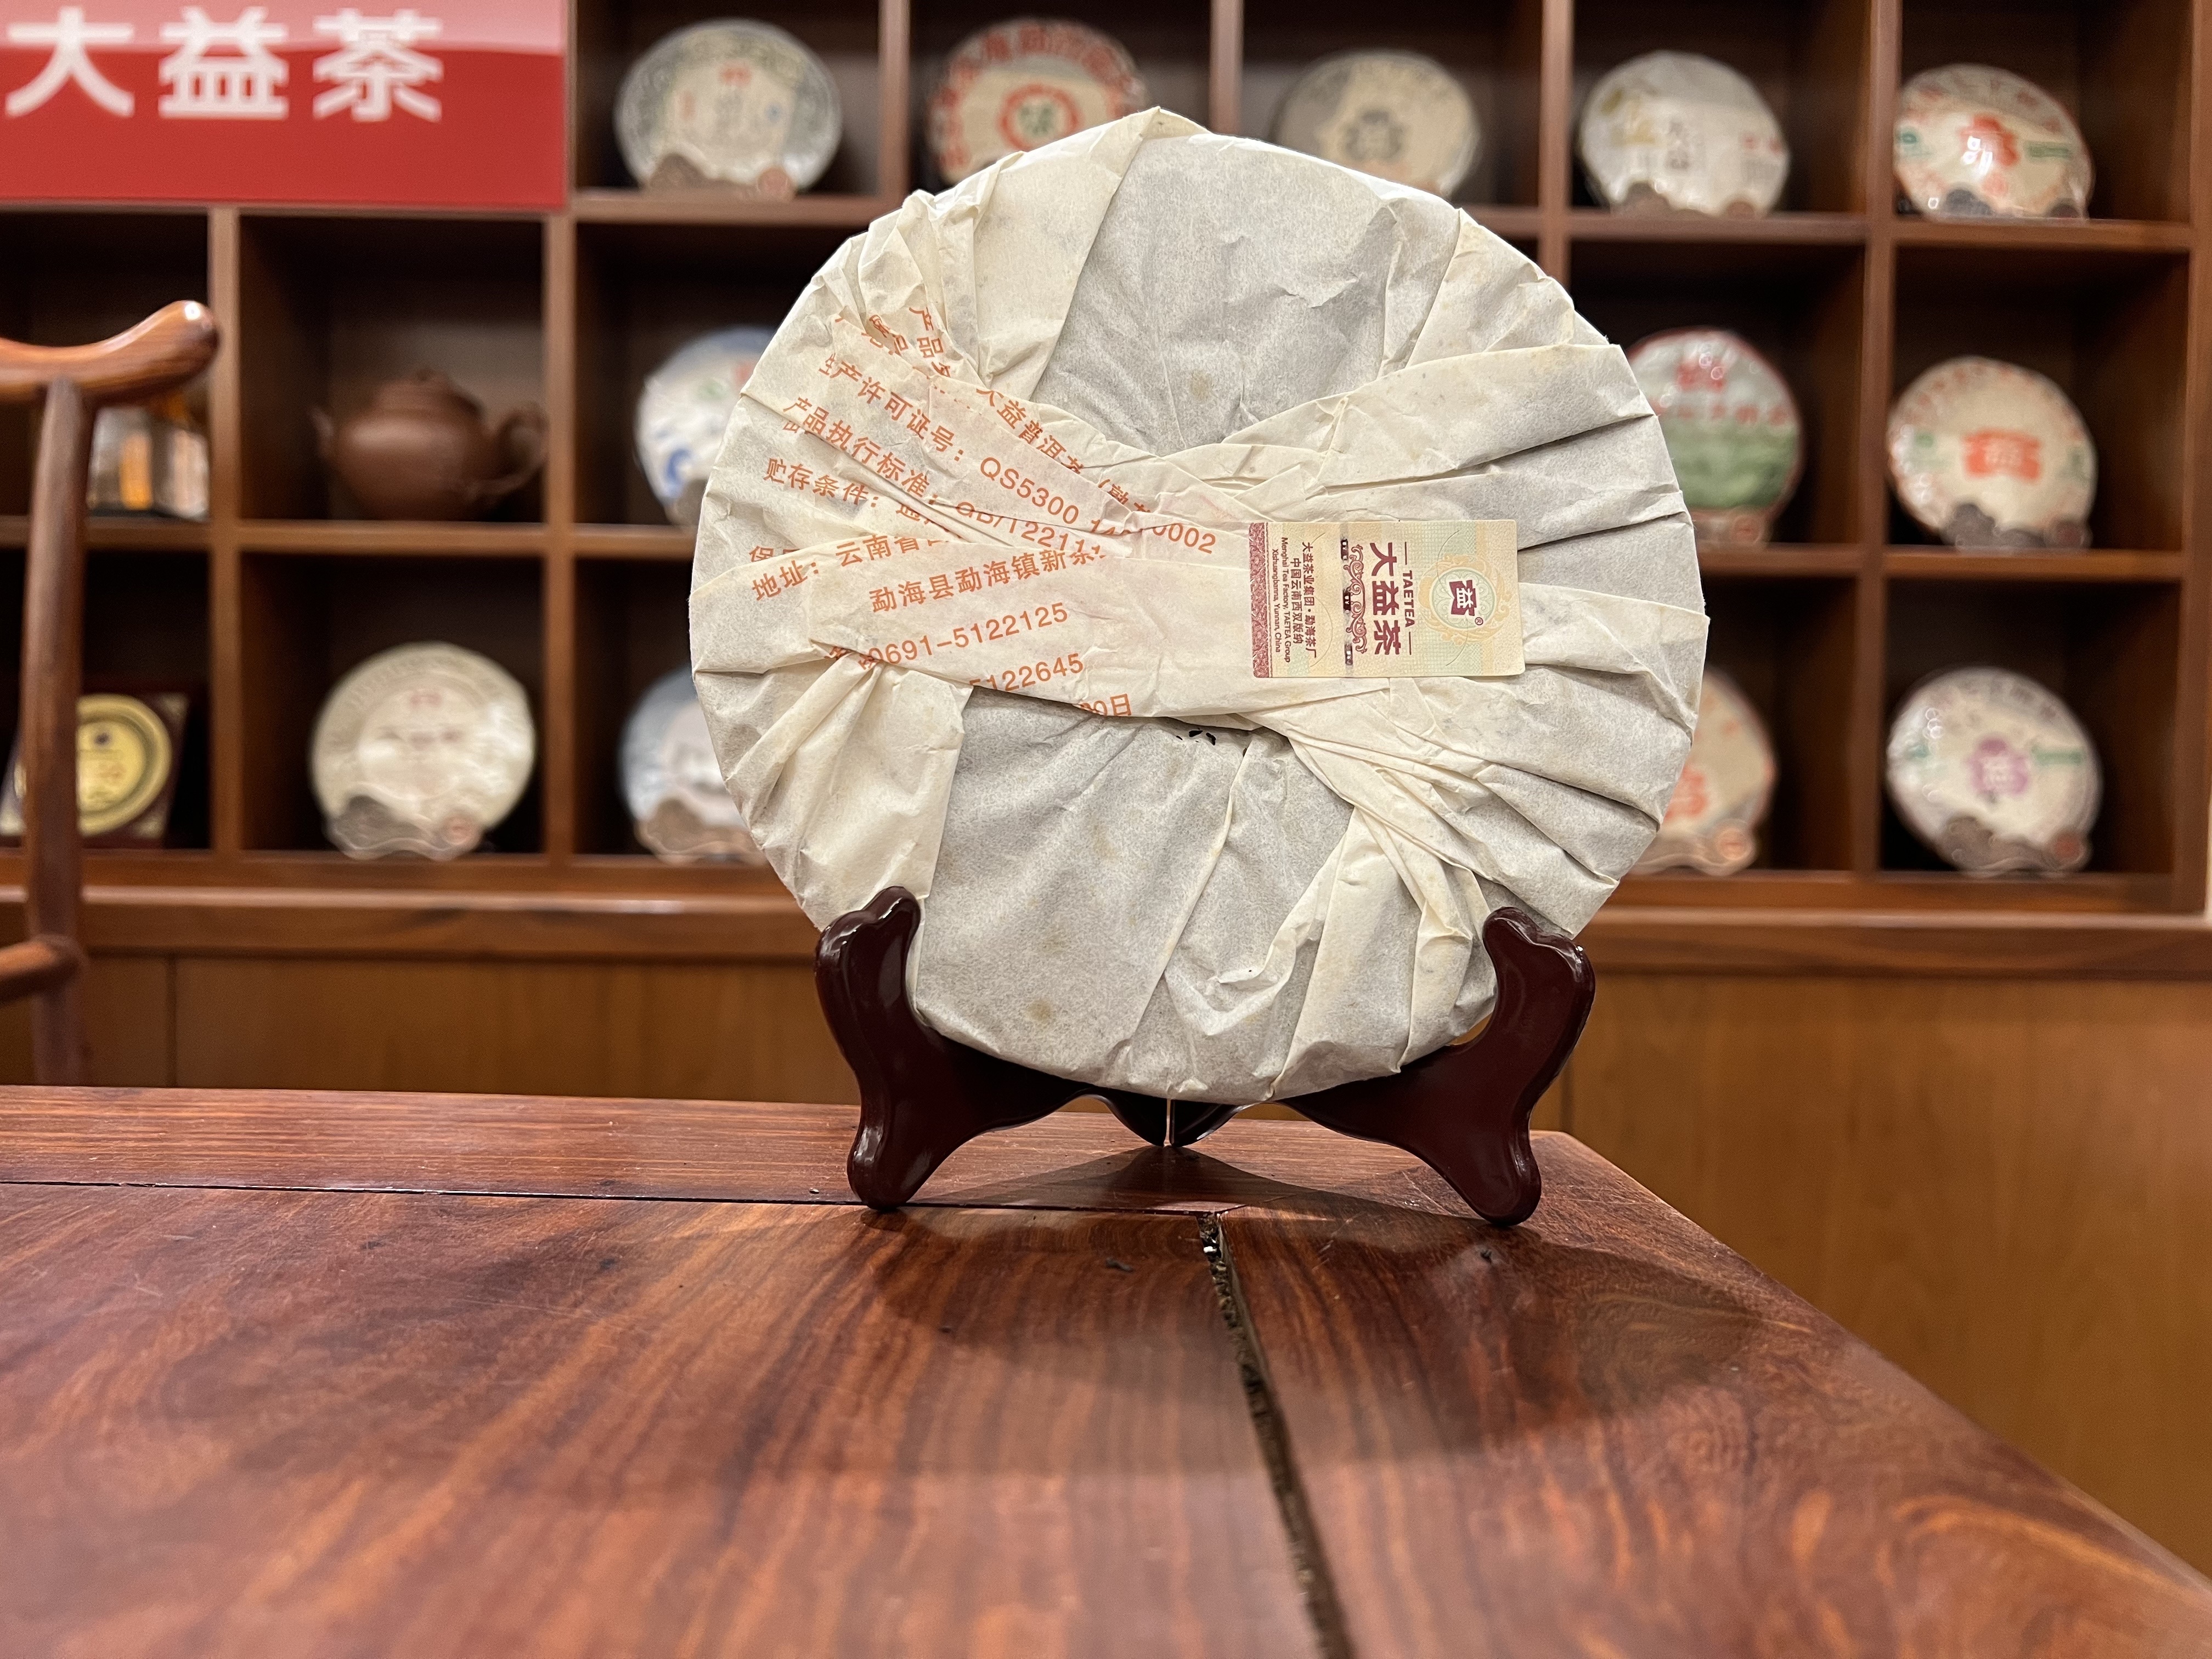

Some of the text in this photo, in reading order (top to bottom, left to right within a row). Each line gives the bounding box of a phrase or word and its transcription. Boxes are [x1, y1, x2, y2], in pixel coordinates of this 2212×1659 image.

[4, 5, 443, 122] 大益茶
[763, 457, 879, 508] 贮存条件：
[980, 456, 1079, 524] QS5300
[752, 534, 943, 601] 地址： 云南省
[1281, 537, 1289, 567] Menghai
[1290, 557, 1304, 644] 中国云南西双版纳
[1370, 542, 1401, 655] 大益茶
[1402, 569, 1415, 628] TAETEA
